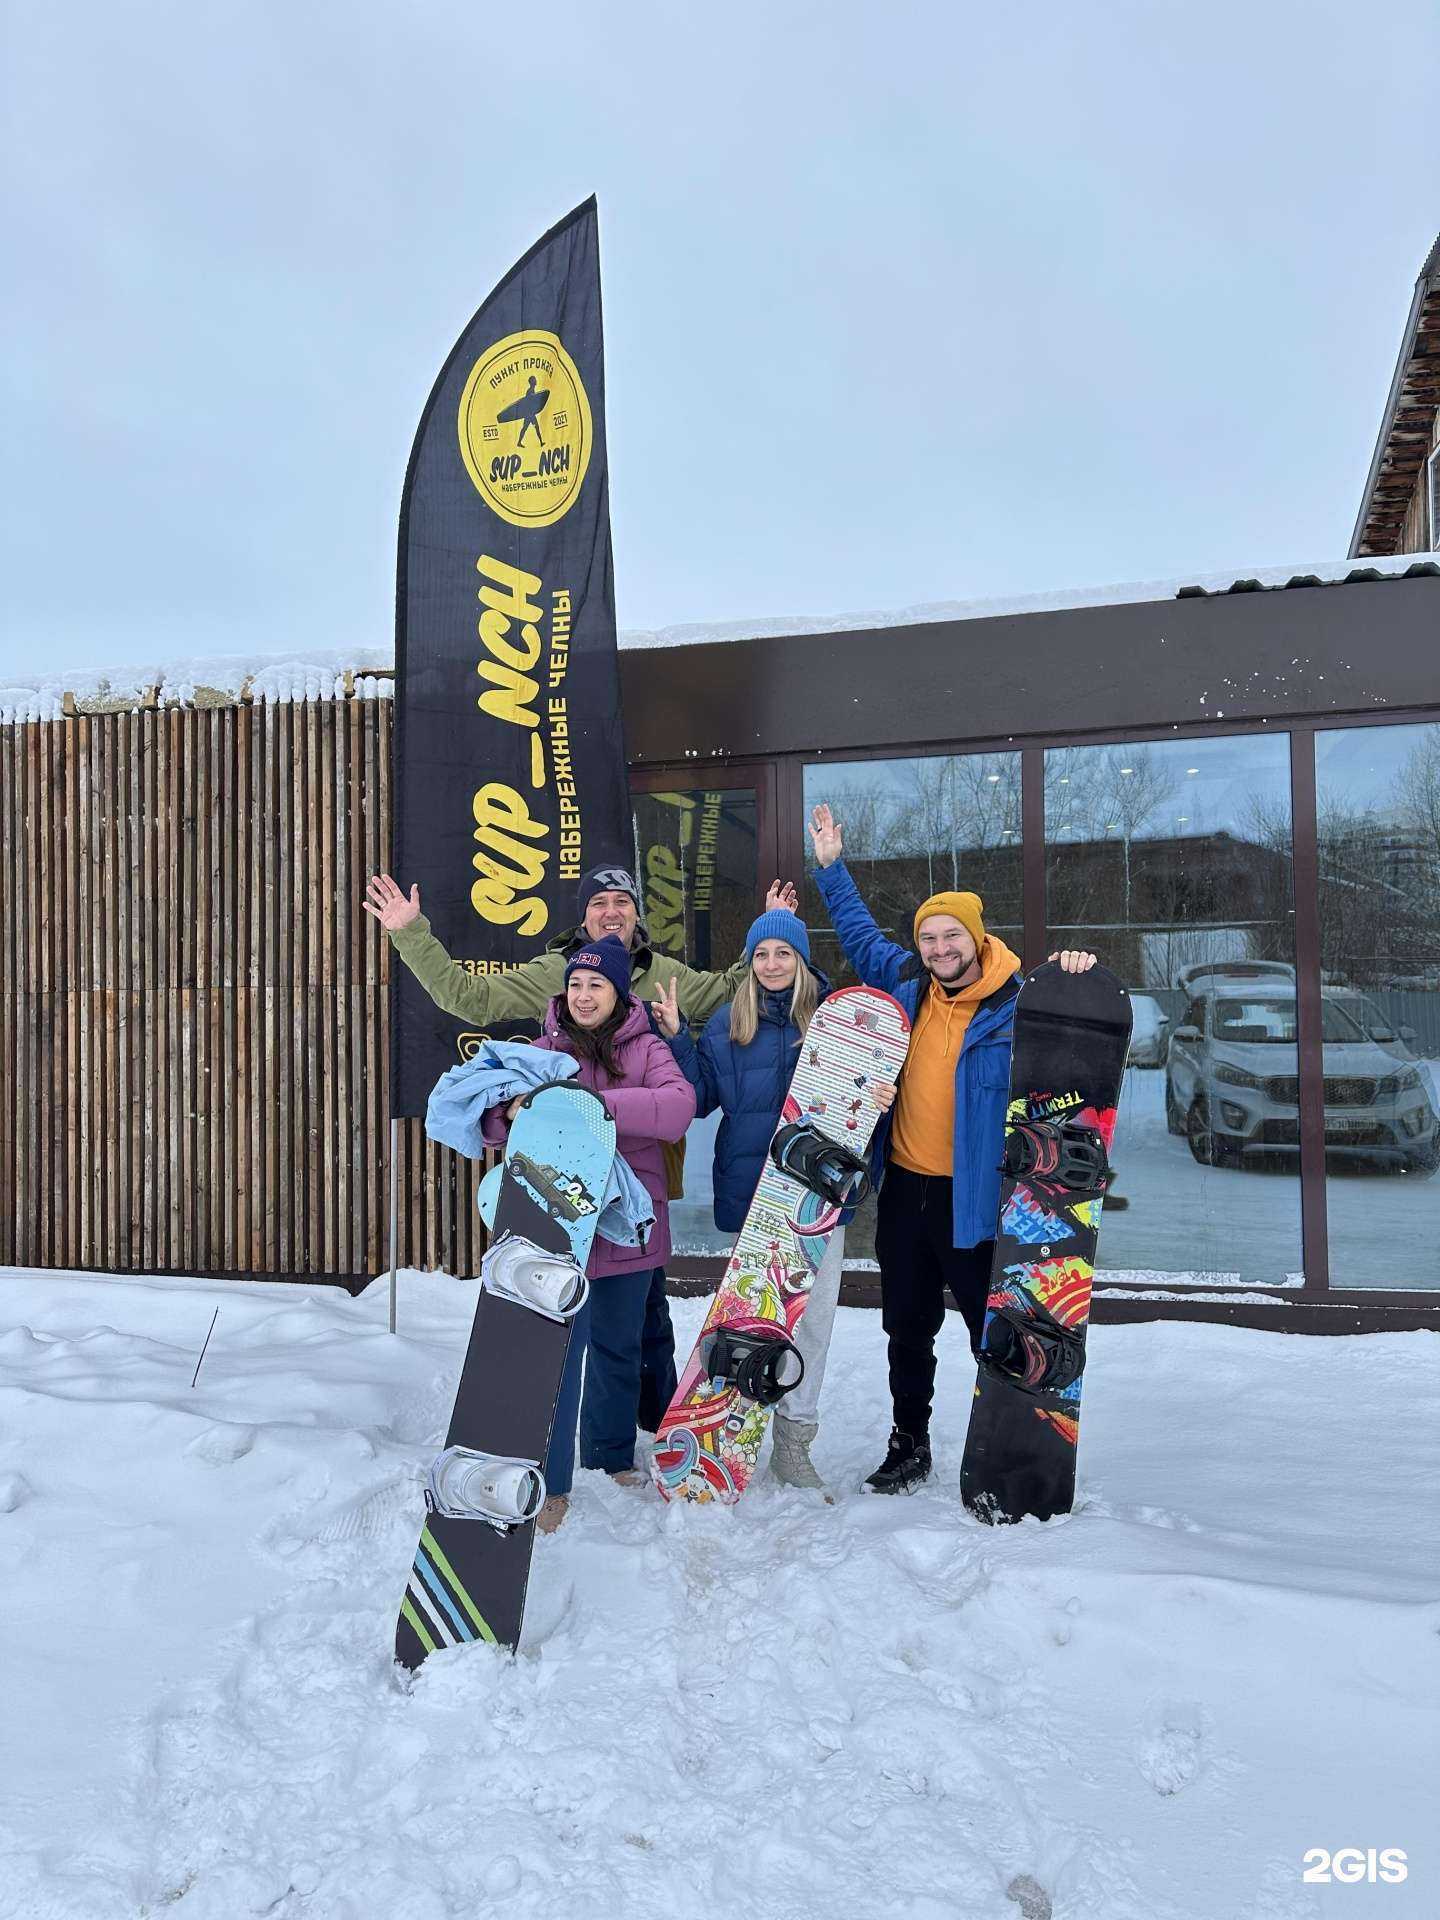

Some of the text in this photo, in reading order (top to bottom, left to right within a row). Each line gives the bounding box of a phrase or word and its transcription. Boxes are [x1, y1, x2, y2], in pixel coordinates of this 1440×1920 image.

[490, 361, 519, 389] ПУНКТ
[483, 428, 498, 438] ESTD
[553, 414, 568, 426] 2021
[490, 444, 570, 482] SUP_NCH
[548, 589, 571, 687] ЧЕЛНЫ
[471, 554, 549, 936] SUP_NCH
[1031, 1090, 1084, 1119] TERMIT
